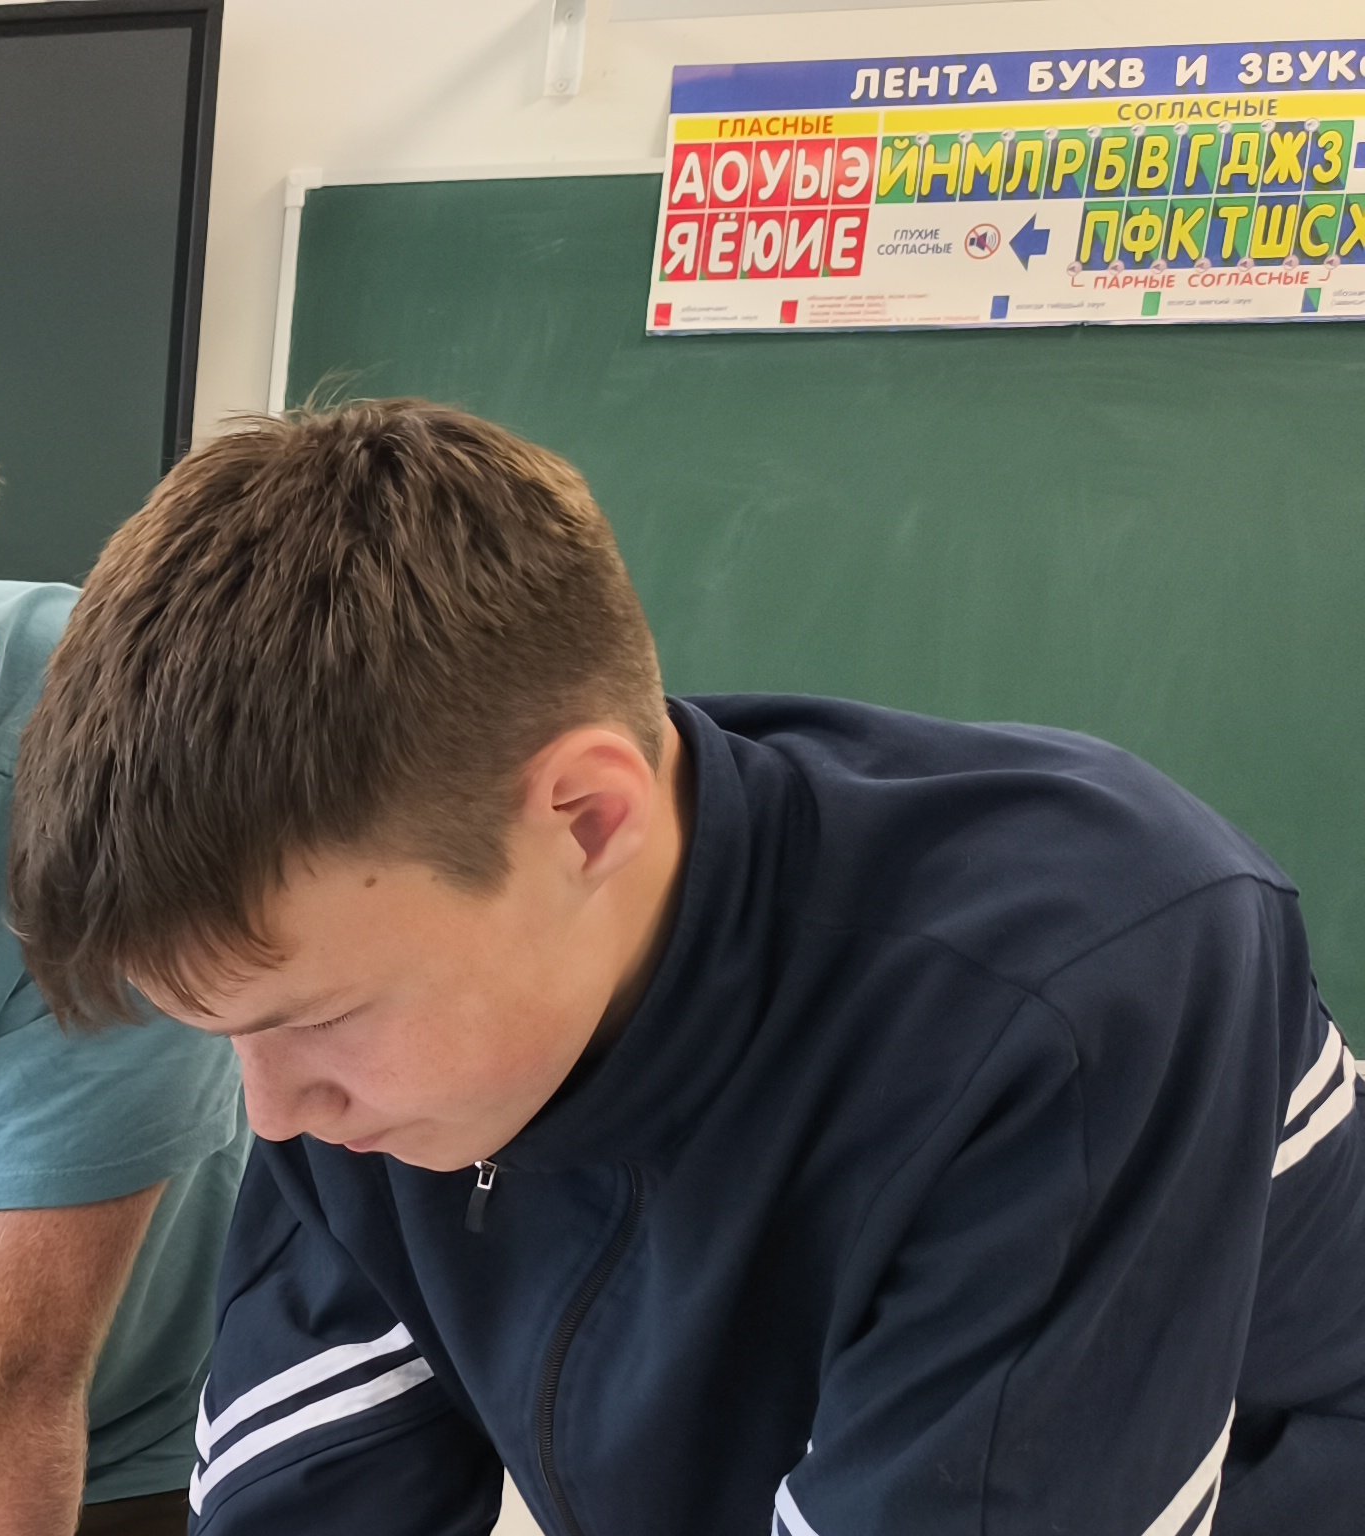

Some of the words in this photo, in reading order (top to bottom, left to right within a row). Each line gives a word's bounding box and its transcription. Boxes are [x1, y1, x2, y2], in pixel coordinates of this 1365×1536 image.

[850, 63, 998, 101] ЛЕНТА
[1028, 57, 1146, 93] БУКВ
[1175, 54, 1208, 87] И
[1237, 50, 1365, 85] ЗВУК
[1117, 98, 1279, 121] СОГЛАСНЫЕ
[718, 115, 834, 138] ГЛАСНЫЕ
[893, 228, 940, 241] ГЛУХИЕ
[877, 242, 953, 256] СОГЛАСНЫЕ
[1093, 275, 1175, 289] ПАРНЫЕ
[1187, 271, 1310, 287] СОГЛАСНЫЕ
